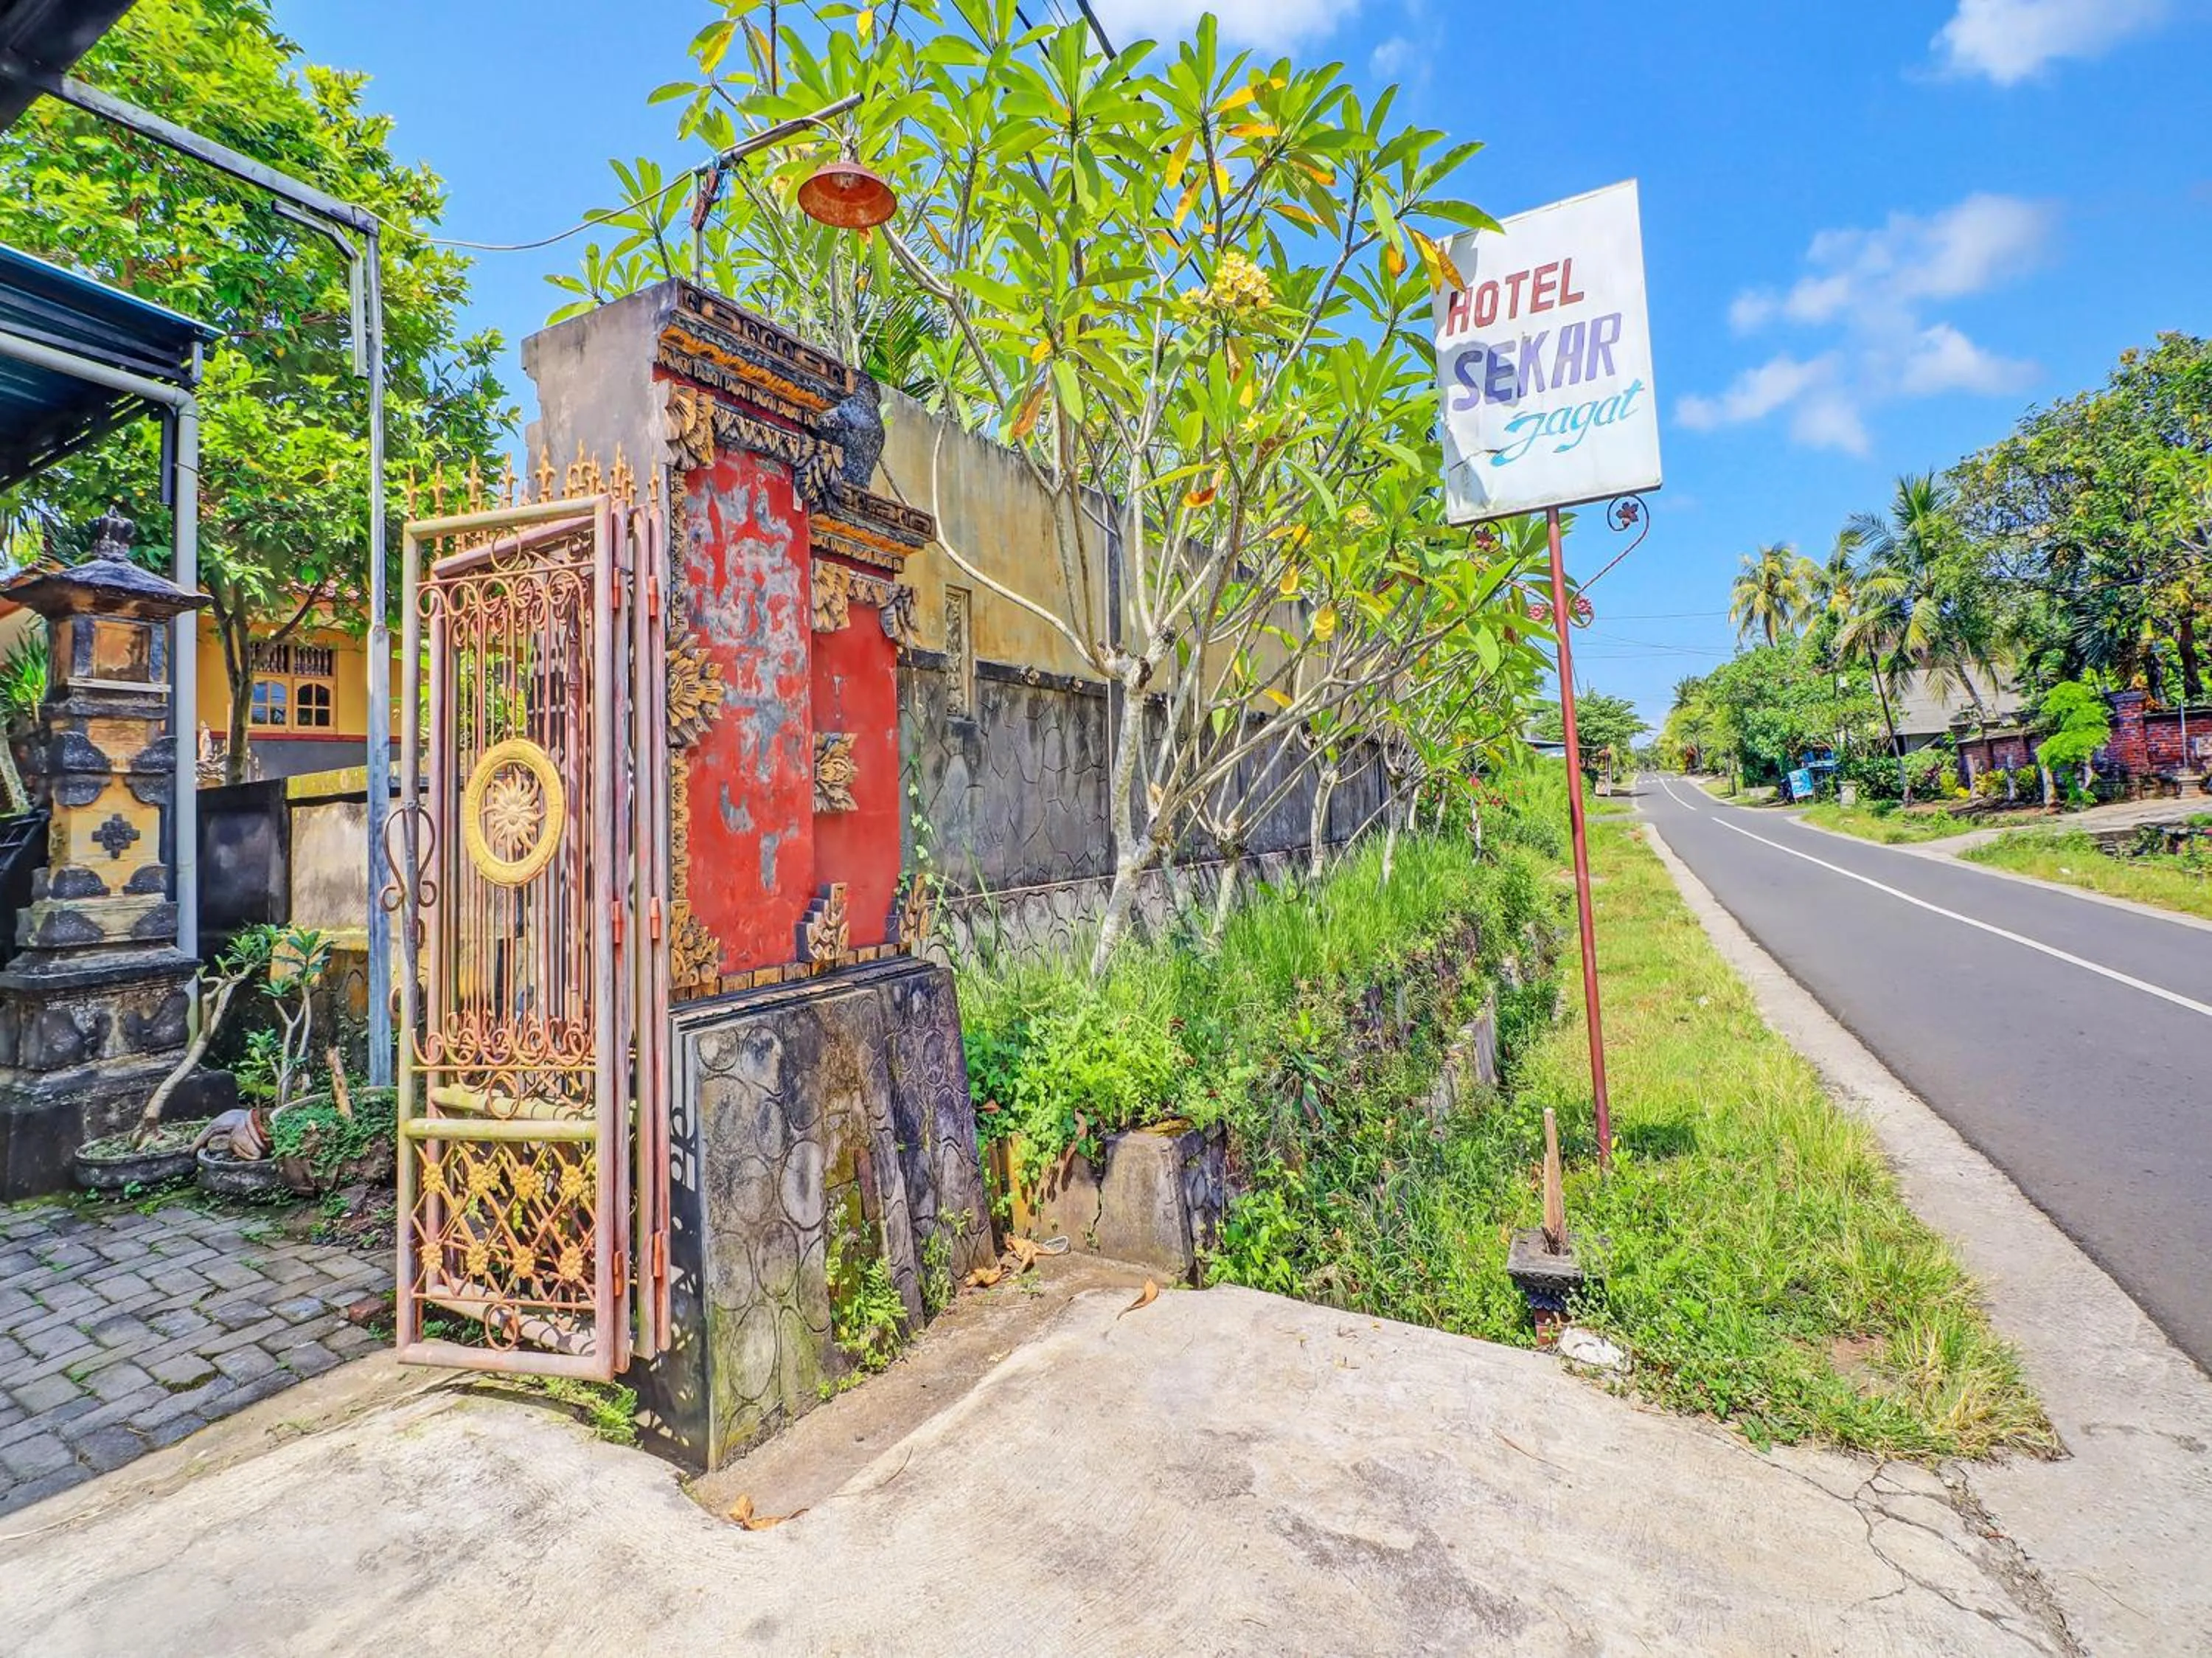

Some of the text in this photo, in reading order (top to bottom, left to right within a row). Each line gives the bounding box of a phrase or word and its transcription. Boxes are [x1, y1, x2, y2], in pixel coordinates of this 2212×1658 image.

[1446, 257, 1585, 337] HOTEL
[1452, 312, 1621, 412] SEKAR
[1489, 378, 1645, 467] Jagat
